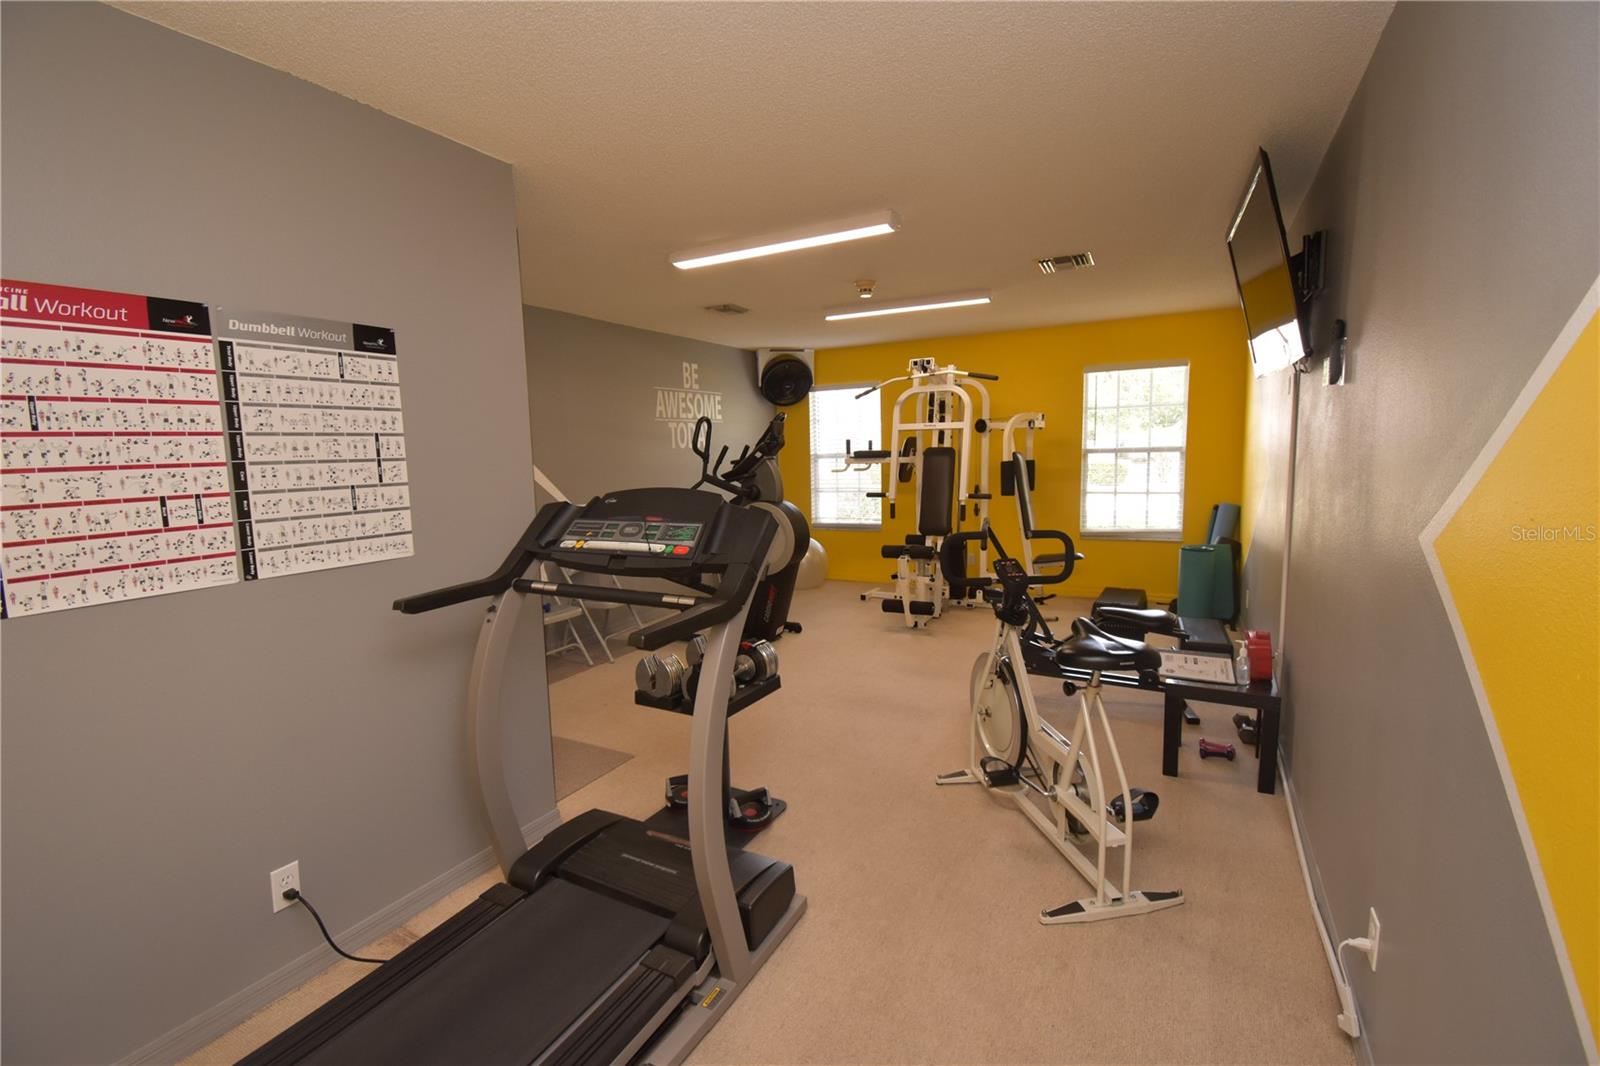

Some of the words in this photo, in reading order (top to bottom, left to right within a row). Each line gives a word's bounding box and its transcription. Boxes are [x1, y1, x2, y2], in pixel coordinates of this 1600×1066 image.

[34, 298, 128, 322] Workout
[228, 319, 295, 337] Dumbbell
[297, 327, 348, 343] Workout
[682, 361, 699, 389] BE
[655, 390, 722, 419] AWESOME
